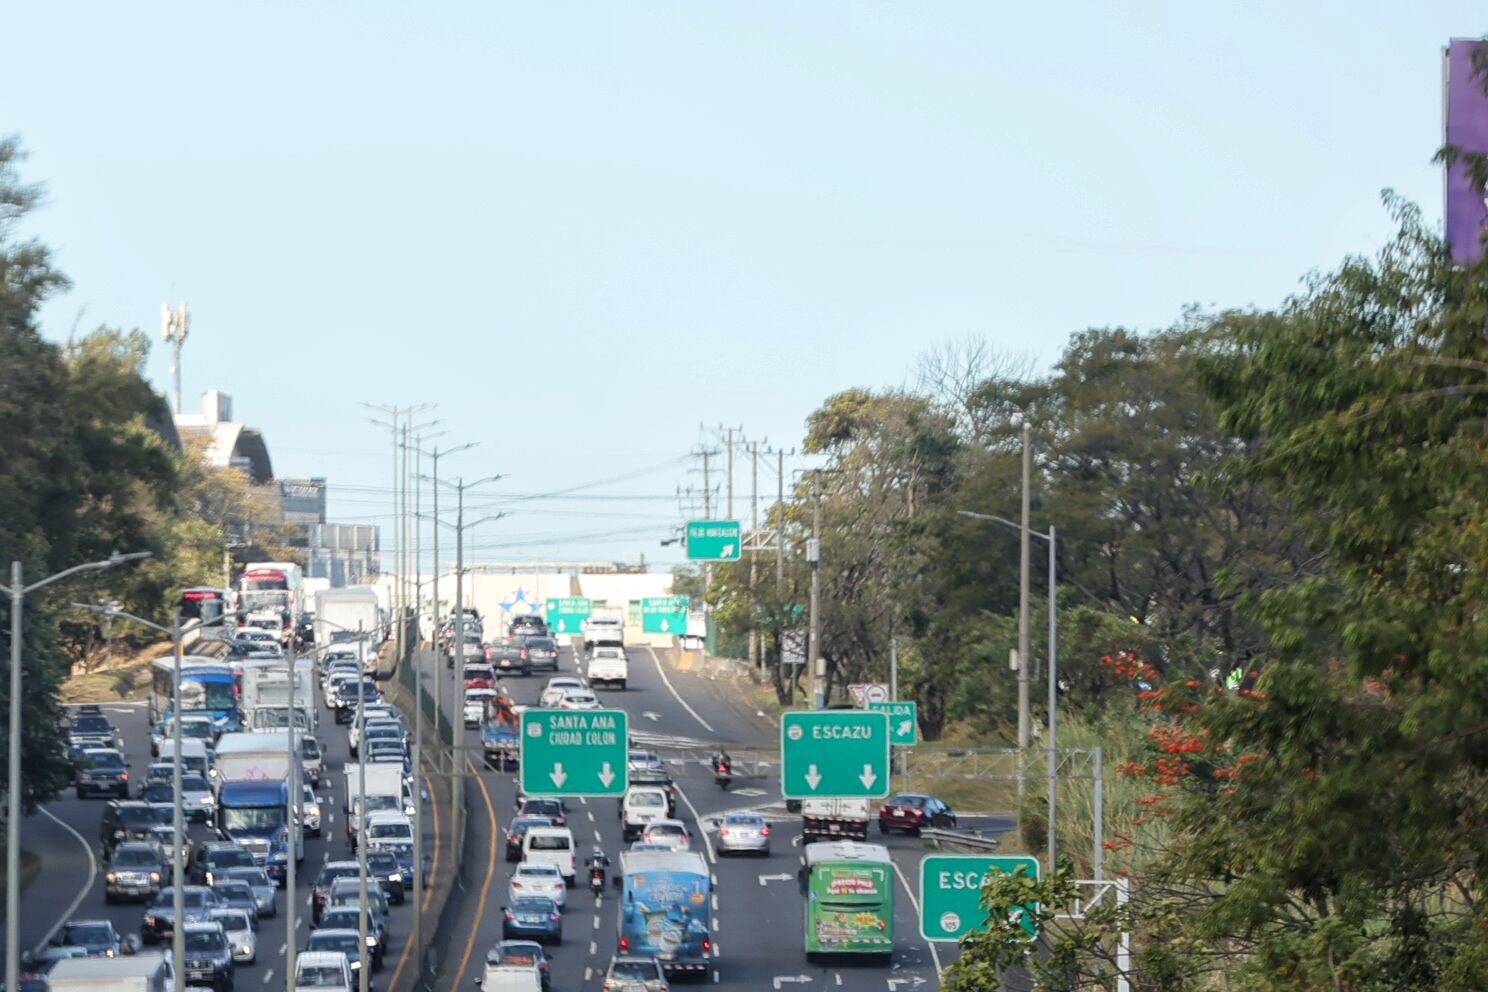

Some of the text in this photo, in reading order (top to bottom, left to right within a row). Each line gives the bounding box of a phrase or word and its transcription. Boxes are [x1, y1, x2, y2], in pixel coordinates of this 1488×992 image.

[549, 715, 616, 729] SANTA ANA
[549, 731, 582, 745] CIUDAD
[812, 726, 872, 739] ESCAZU
